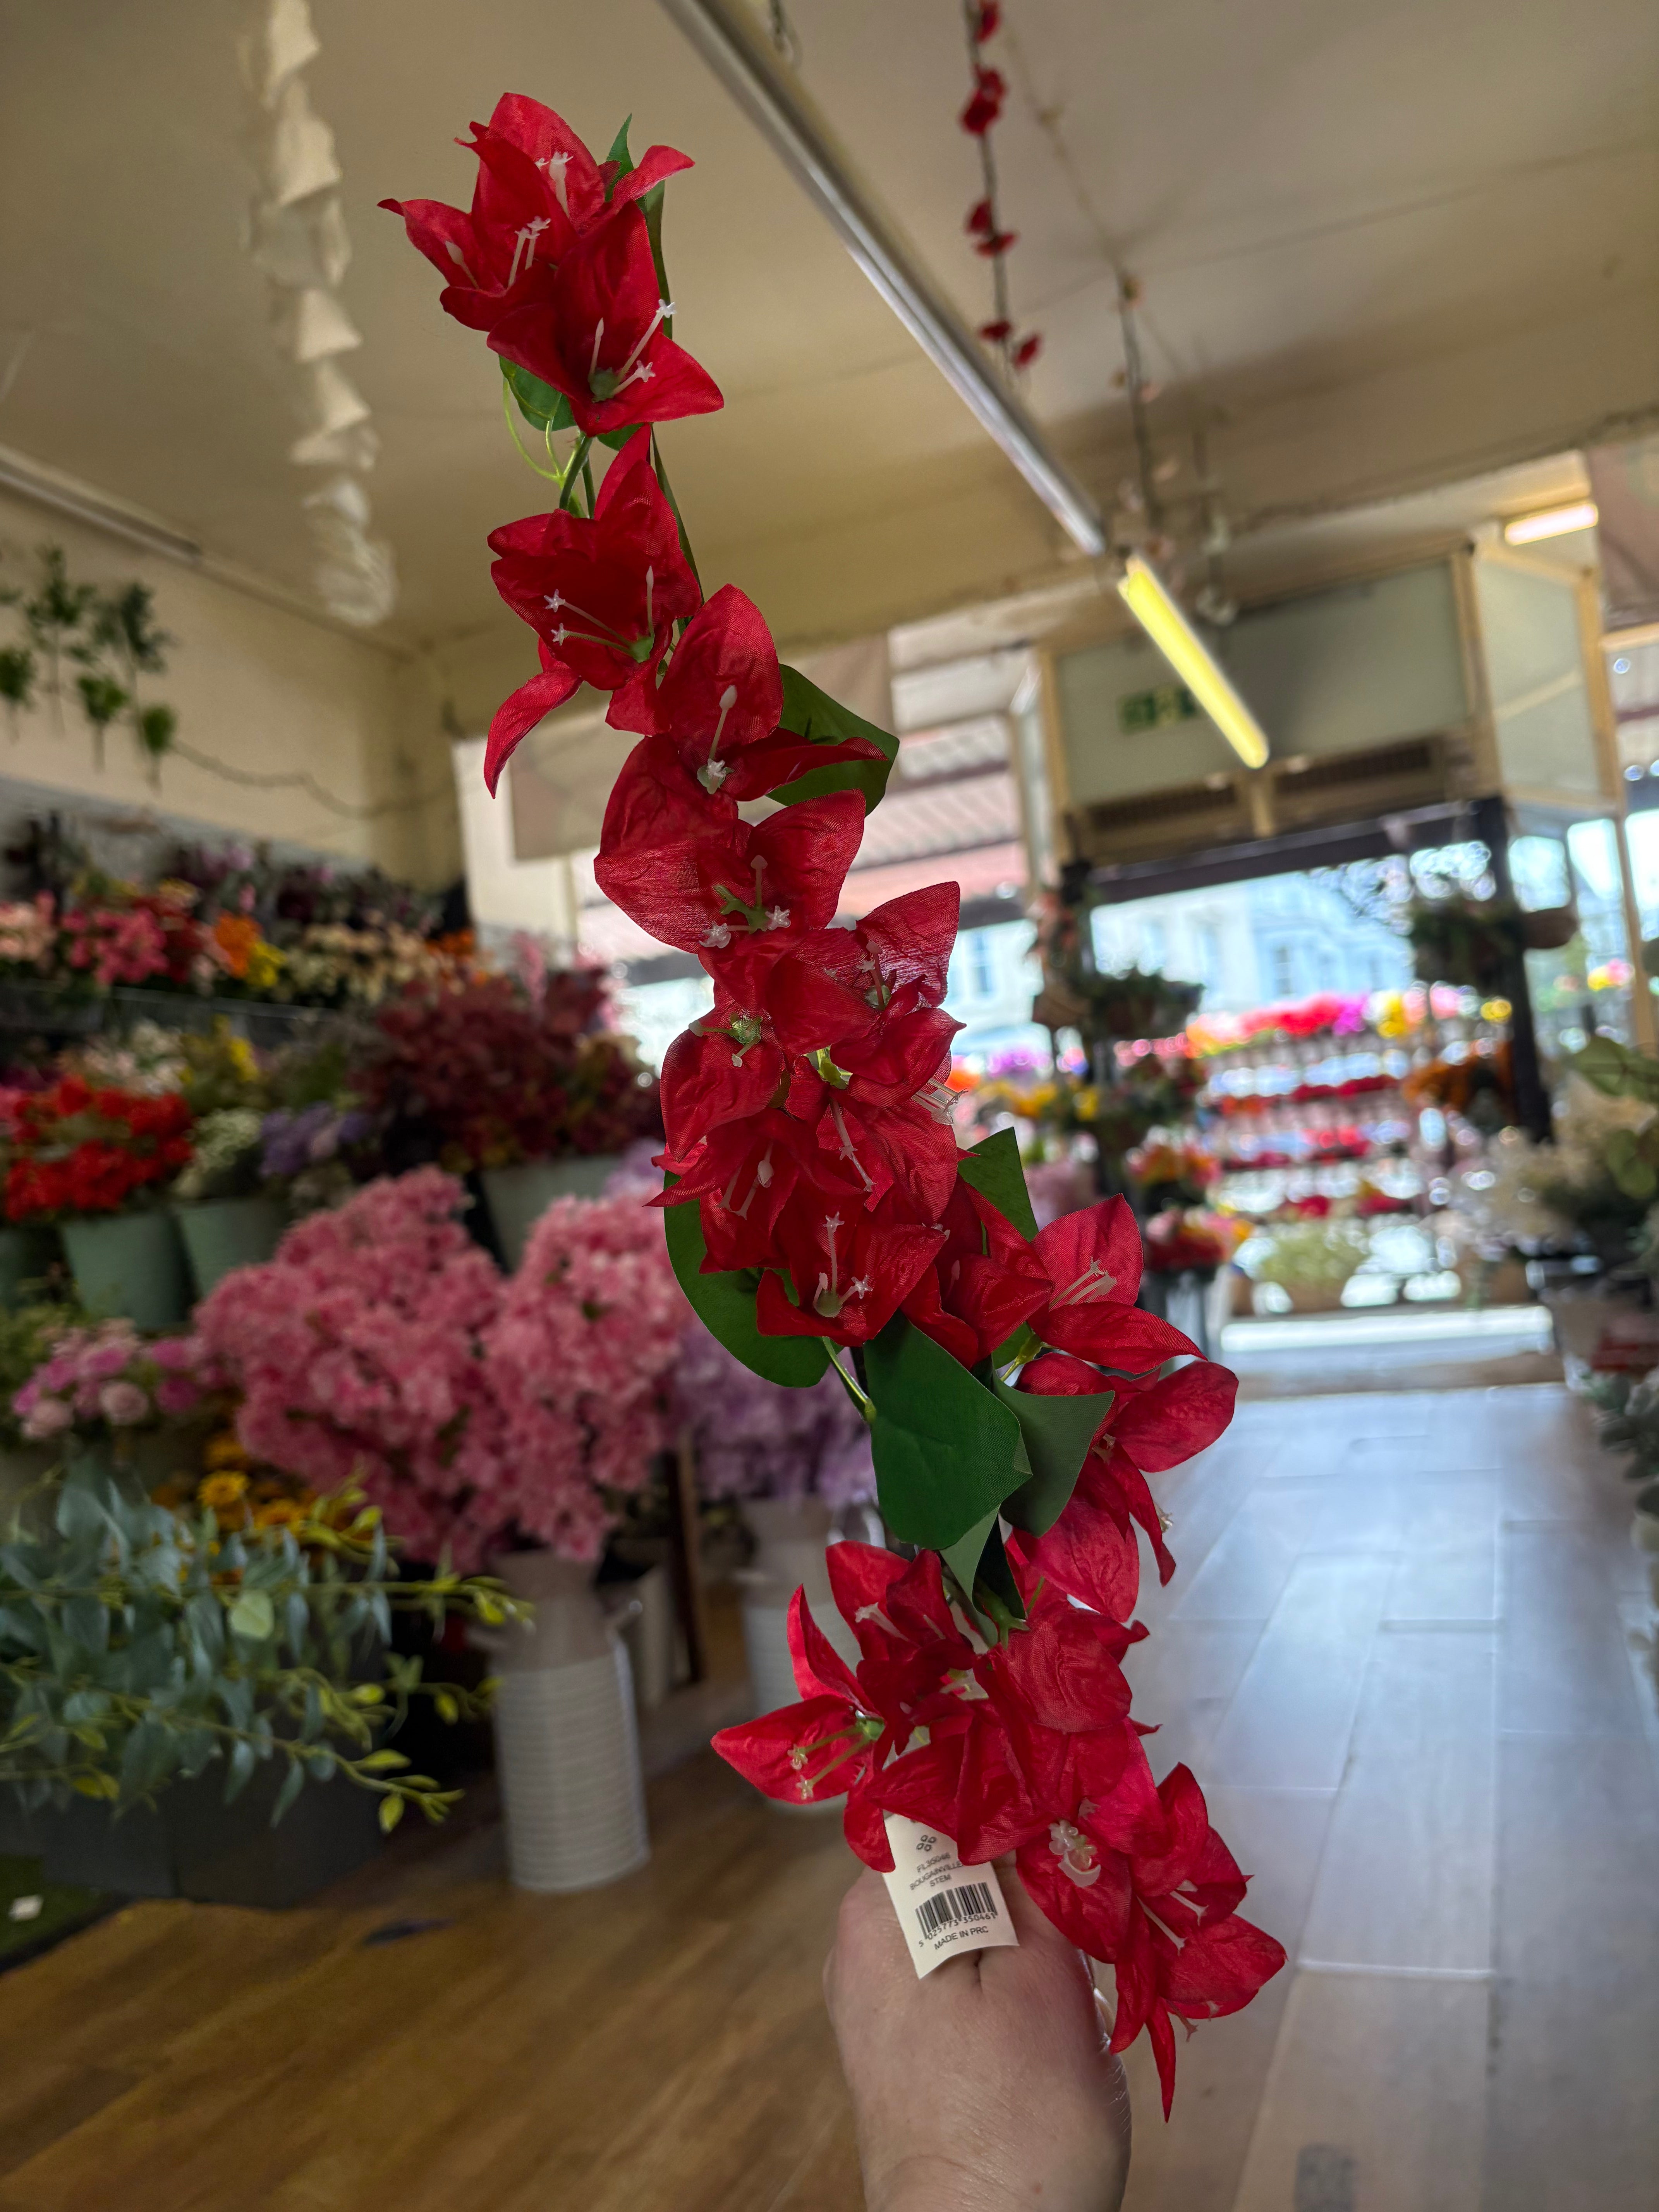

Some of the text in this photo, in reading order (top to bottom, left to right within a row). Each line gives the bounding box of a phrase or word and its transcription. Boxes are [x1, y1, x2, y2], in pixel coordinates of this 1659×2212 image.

[910, 1860, 963, 1890] BOUGAINVILLE
[930, 1874, 951, 1887] STEM
[927, 1919, 958, 1940] 025773
[963, 1913, 996, 1923] 350461
[934, 1932, 958, 1950] MADE
[970, 1926, 989, 1935] PRC
